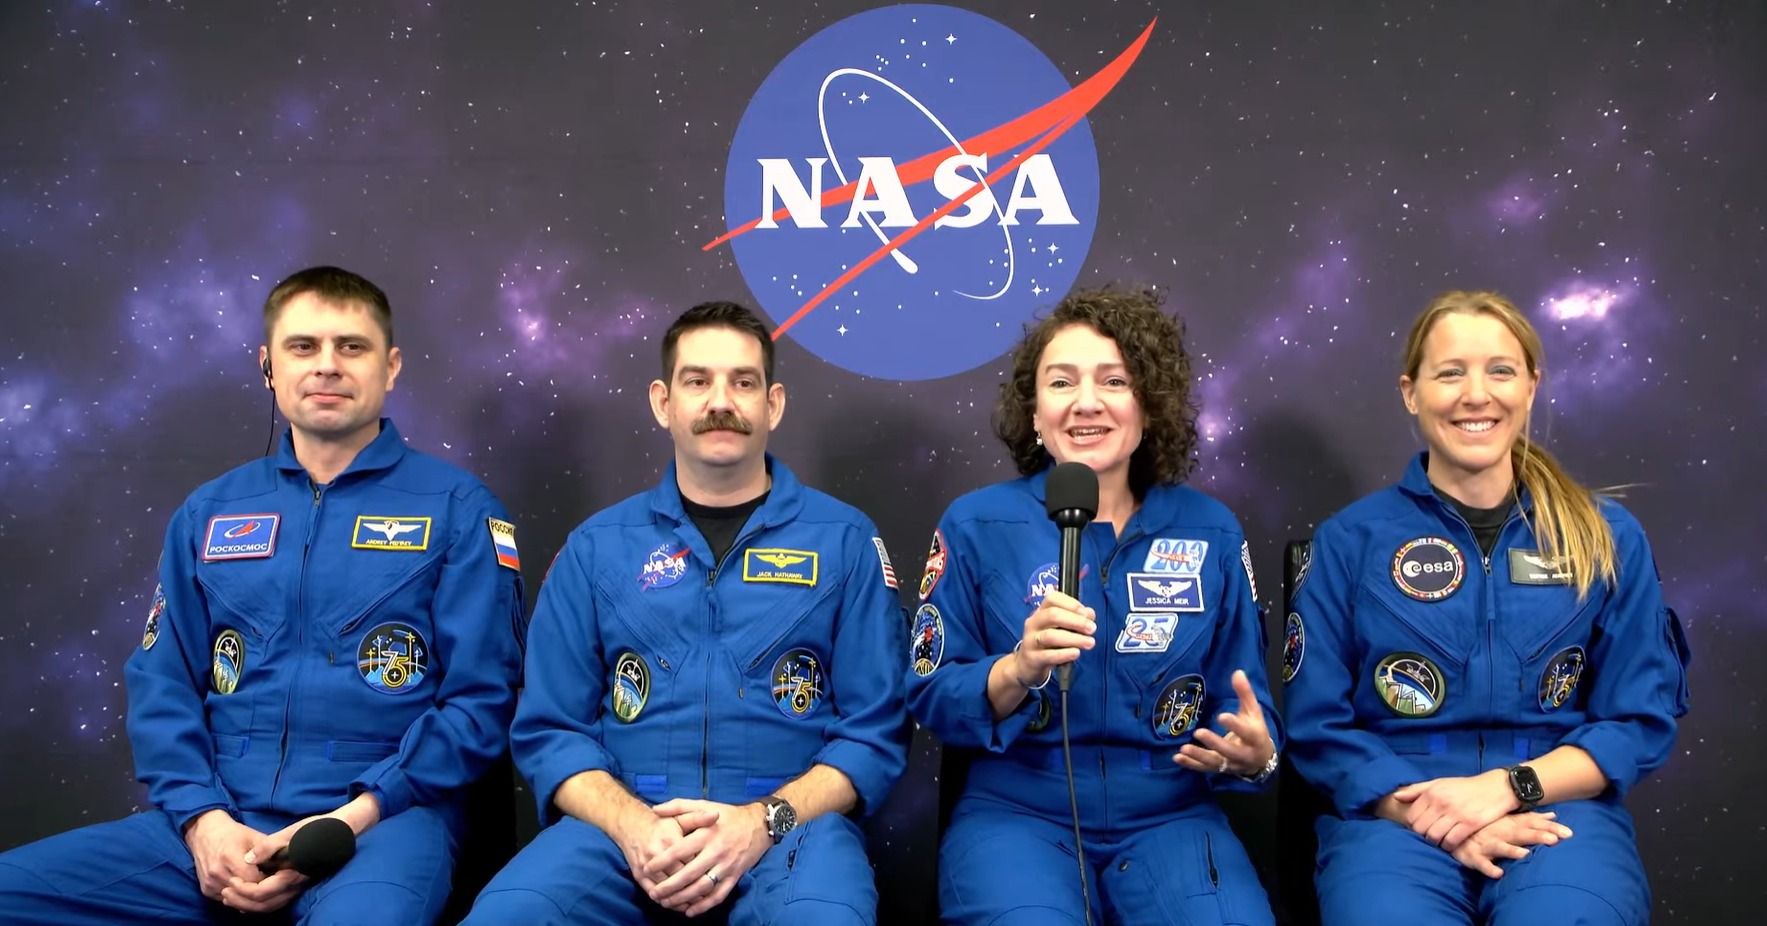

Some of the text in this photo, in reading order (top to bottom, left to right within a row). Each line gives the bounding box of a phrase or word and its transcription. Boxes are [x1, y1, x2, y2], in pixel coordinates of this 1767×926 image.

[754, 152, 1080, 231] NASA
[209, 543, 268, 554] РОСКОСМОС
[1151, 540, 1204, 571] 200
[643, 556, 686, 575] NASA
[1422, 560, 1454, 574] esa
[1145, 596, 1189, 606] JESSICA MEIR
[381, 650, 410, 688] 75
[790, 676, 811, 713] 75
